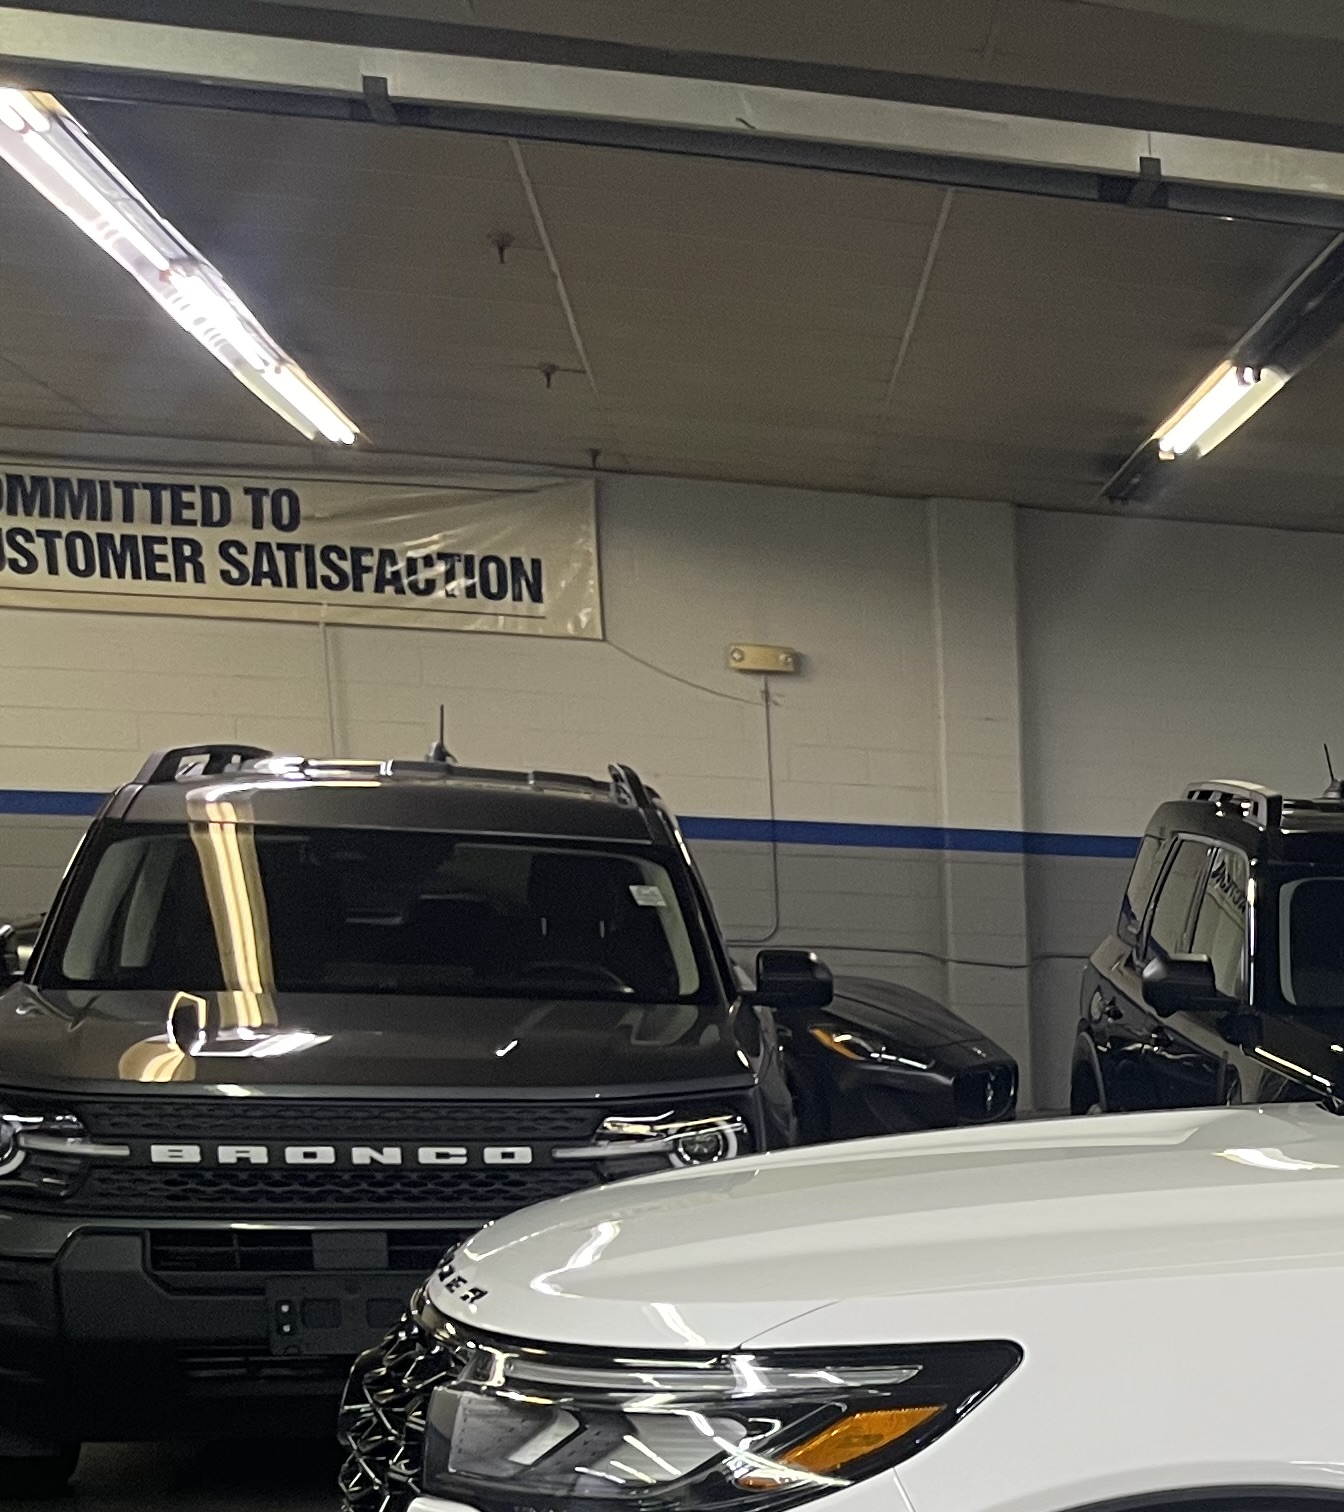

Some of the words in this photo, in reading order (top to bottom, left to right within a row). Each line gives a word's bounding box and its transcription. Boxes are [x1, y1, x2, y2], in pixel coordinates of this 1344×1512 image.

[0, 472, 232, 529] MMITTED
[243, 486, 301, 532] TO
[218, 537, 545, 604] SATISFACTION
[150, 1144, 533, 1165] BRONCO
